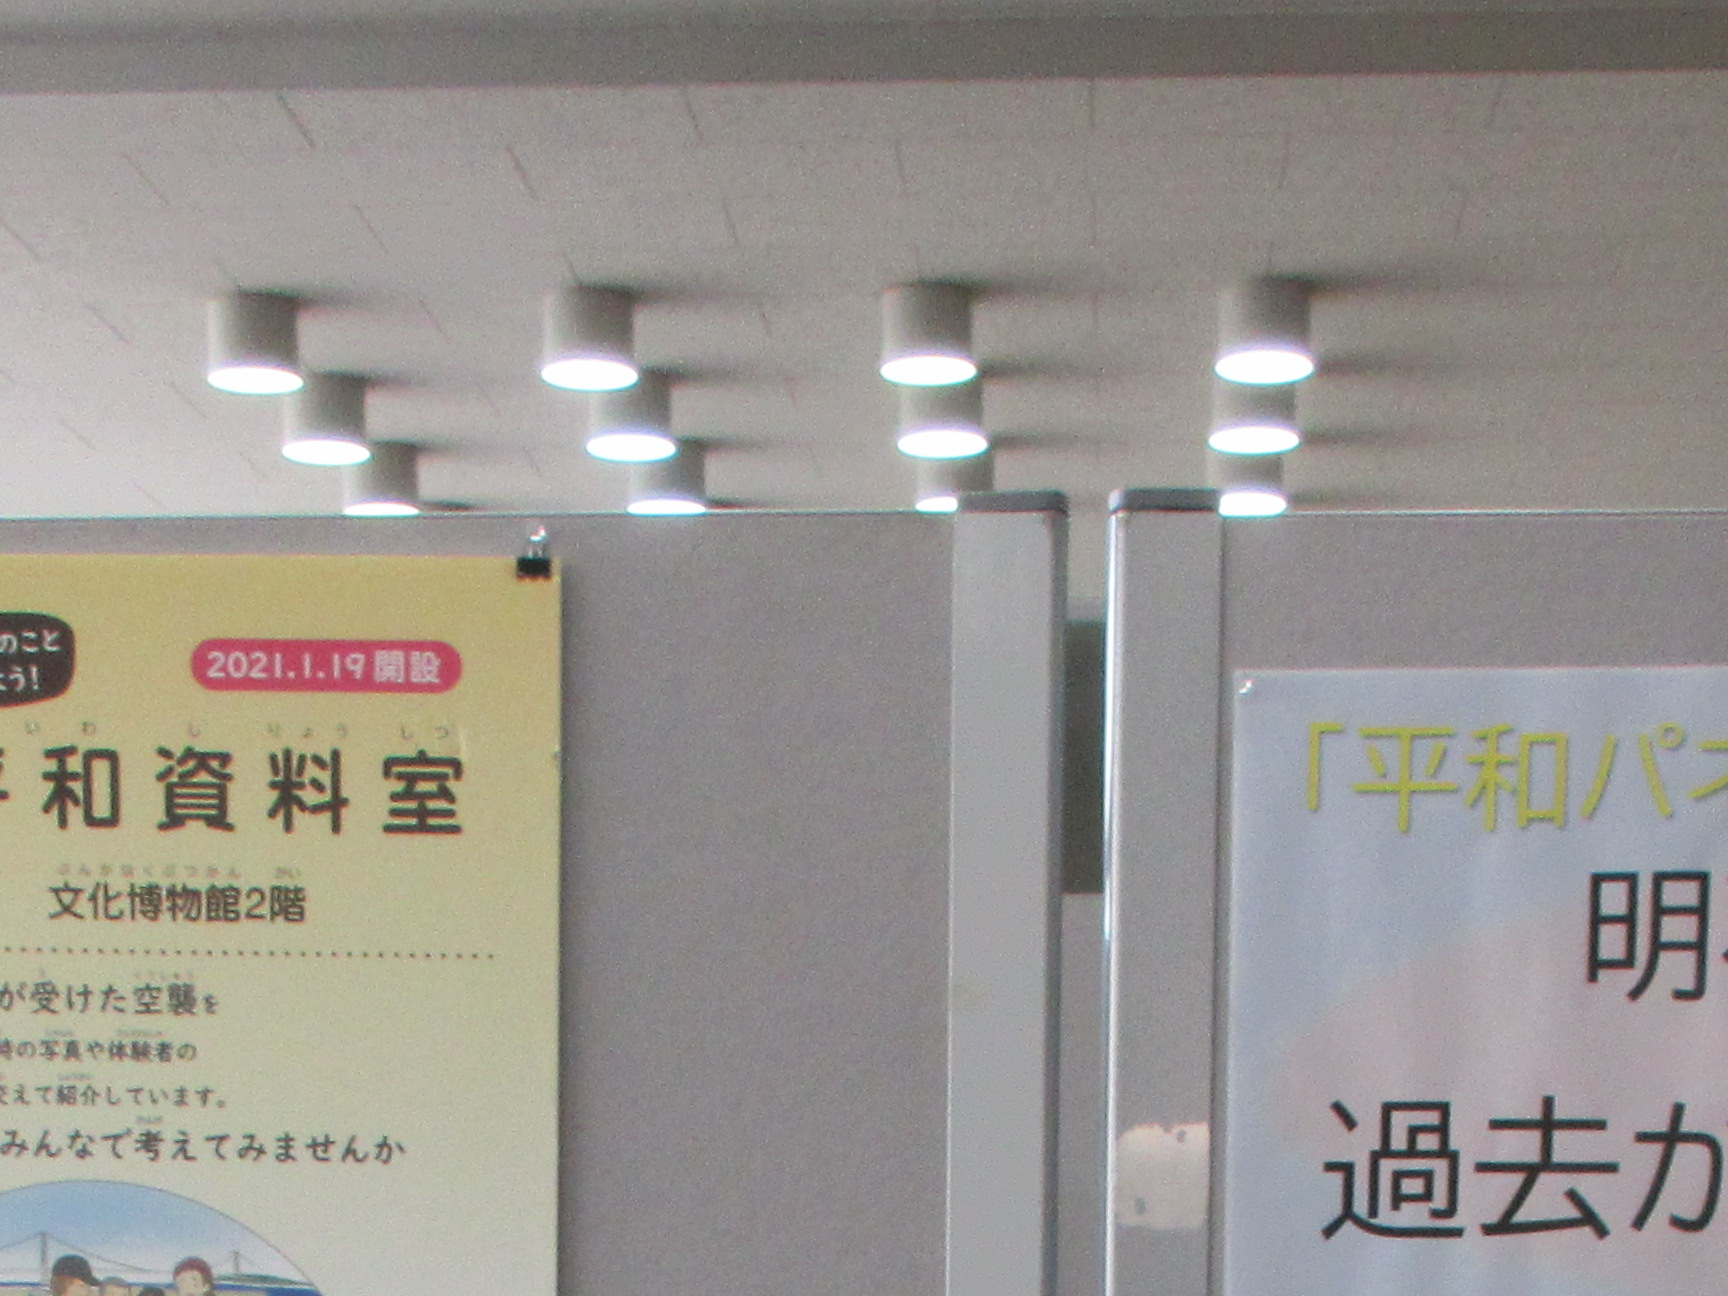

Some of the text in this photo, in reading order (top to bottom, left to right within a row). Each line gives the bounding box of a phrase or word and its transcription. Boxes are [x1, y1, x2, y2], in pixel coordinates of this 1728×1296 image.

[205, 649, 442, 686] 2021.1.19 開設
[47, 880, 308, 924] 文化博物館2階
